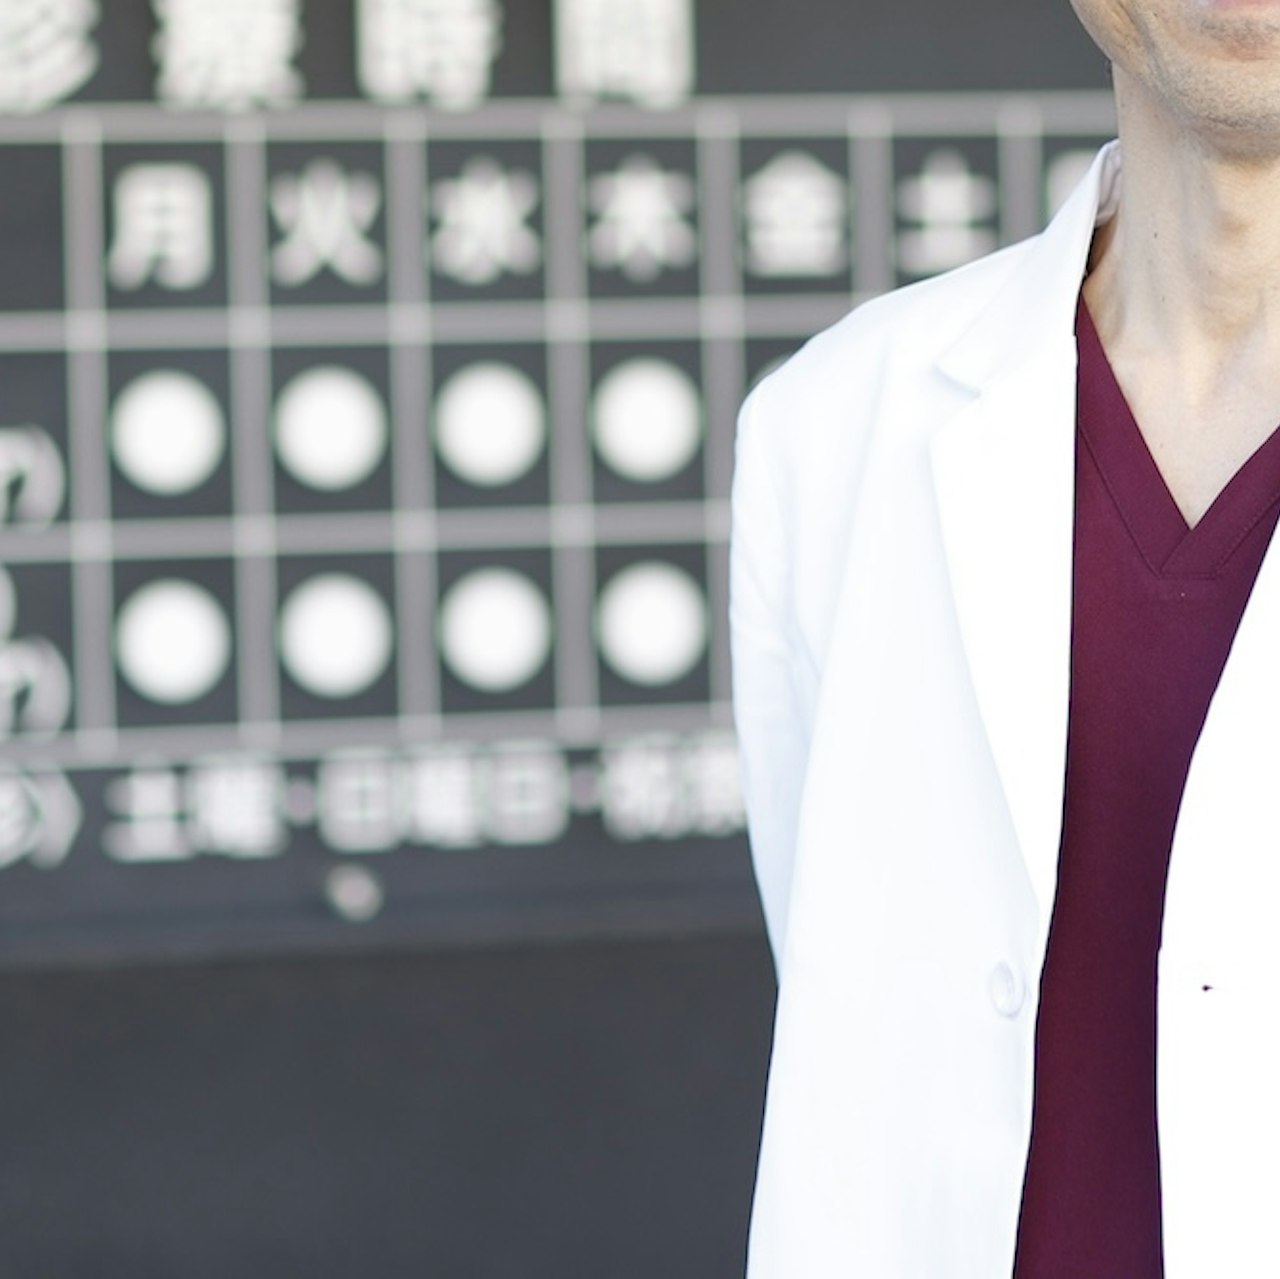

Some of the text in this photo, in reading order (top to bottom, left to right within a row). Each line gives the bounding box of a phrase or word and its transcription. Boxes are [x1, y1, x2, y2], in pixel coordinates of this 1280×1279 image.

[107, 160, 214, 292] 月
[268, 156, 384, 288] 火
[427, 154, 544, 286] 水
[584, 152, 701, 284] 木
[742, 148, 849, 280] 金
[895, 147, 998, 278] 土
